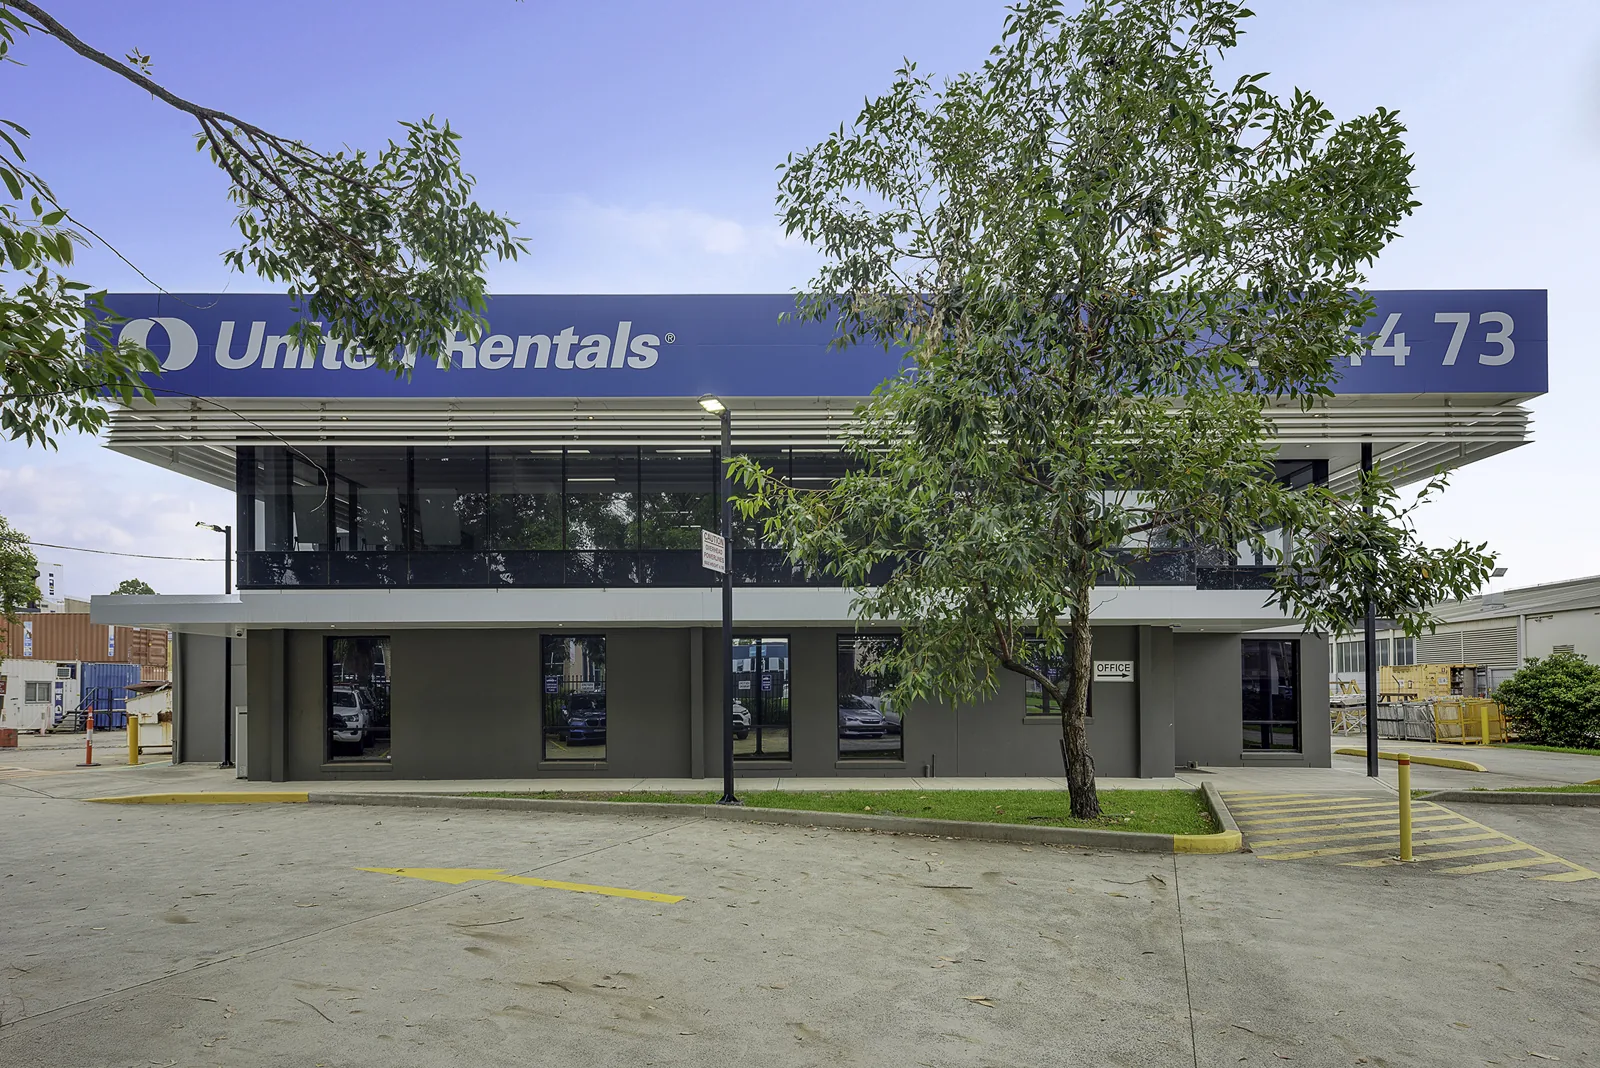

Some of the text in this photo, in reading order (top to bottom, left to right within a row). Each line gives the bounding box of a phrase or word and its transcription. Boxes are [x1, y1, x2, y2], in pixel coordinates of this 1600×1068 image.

[1433, 311, 1516, 367] 73
[704, 532, 724, 546] CAUTION
[705, 544, 723, 556] OVERHEAD
[1097, 664, 1130, 672] OFFICE
